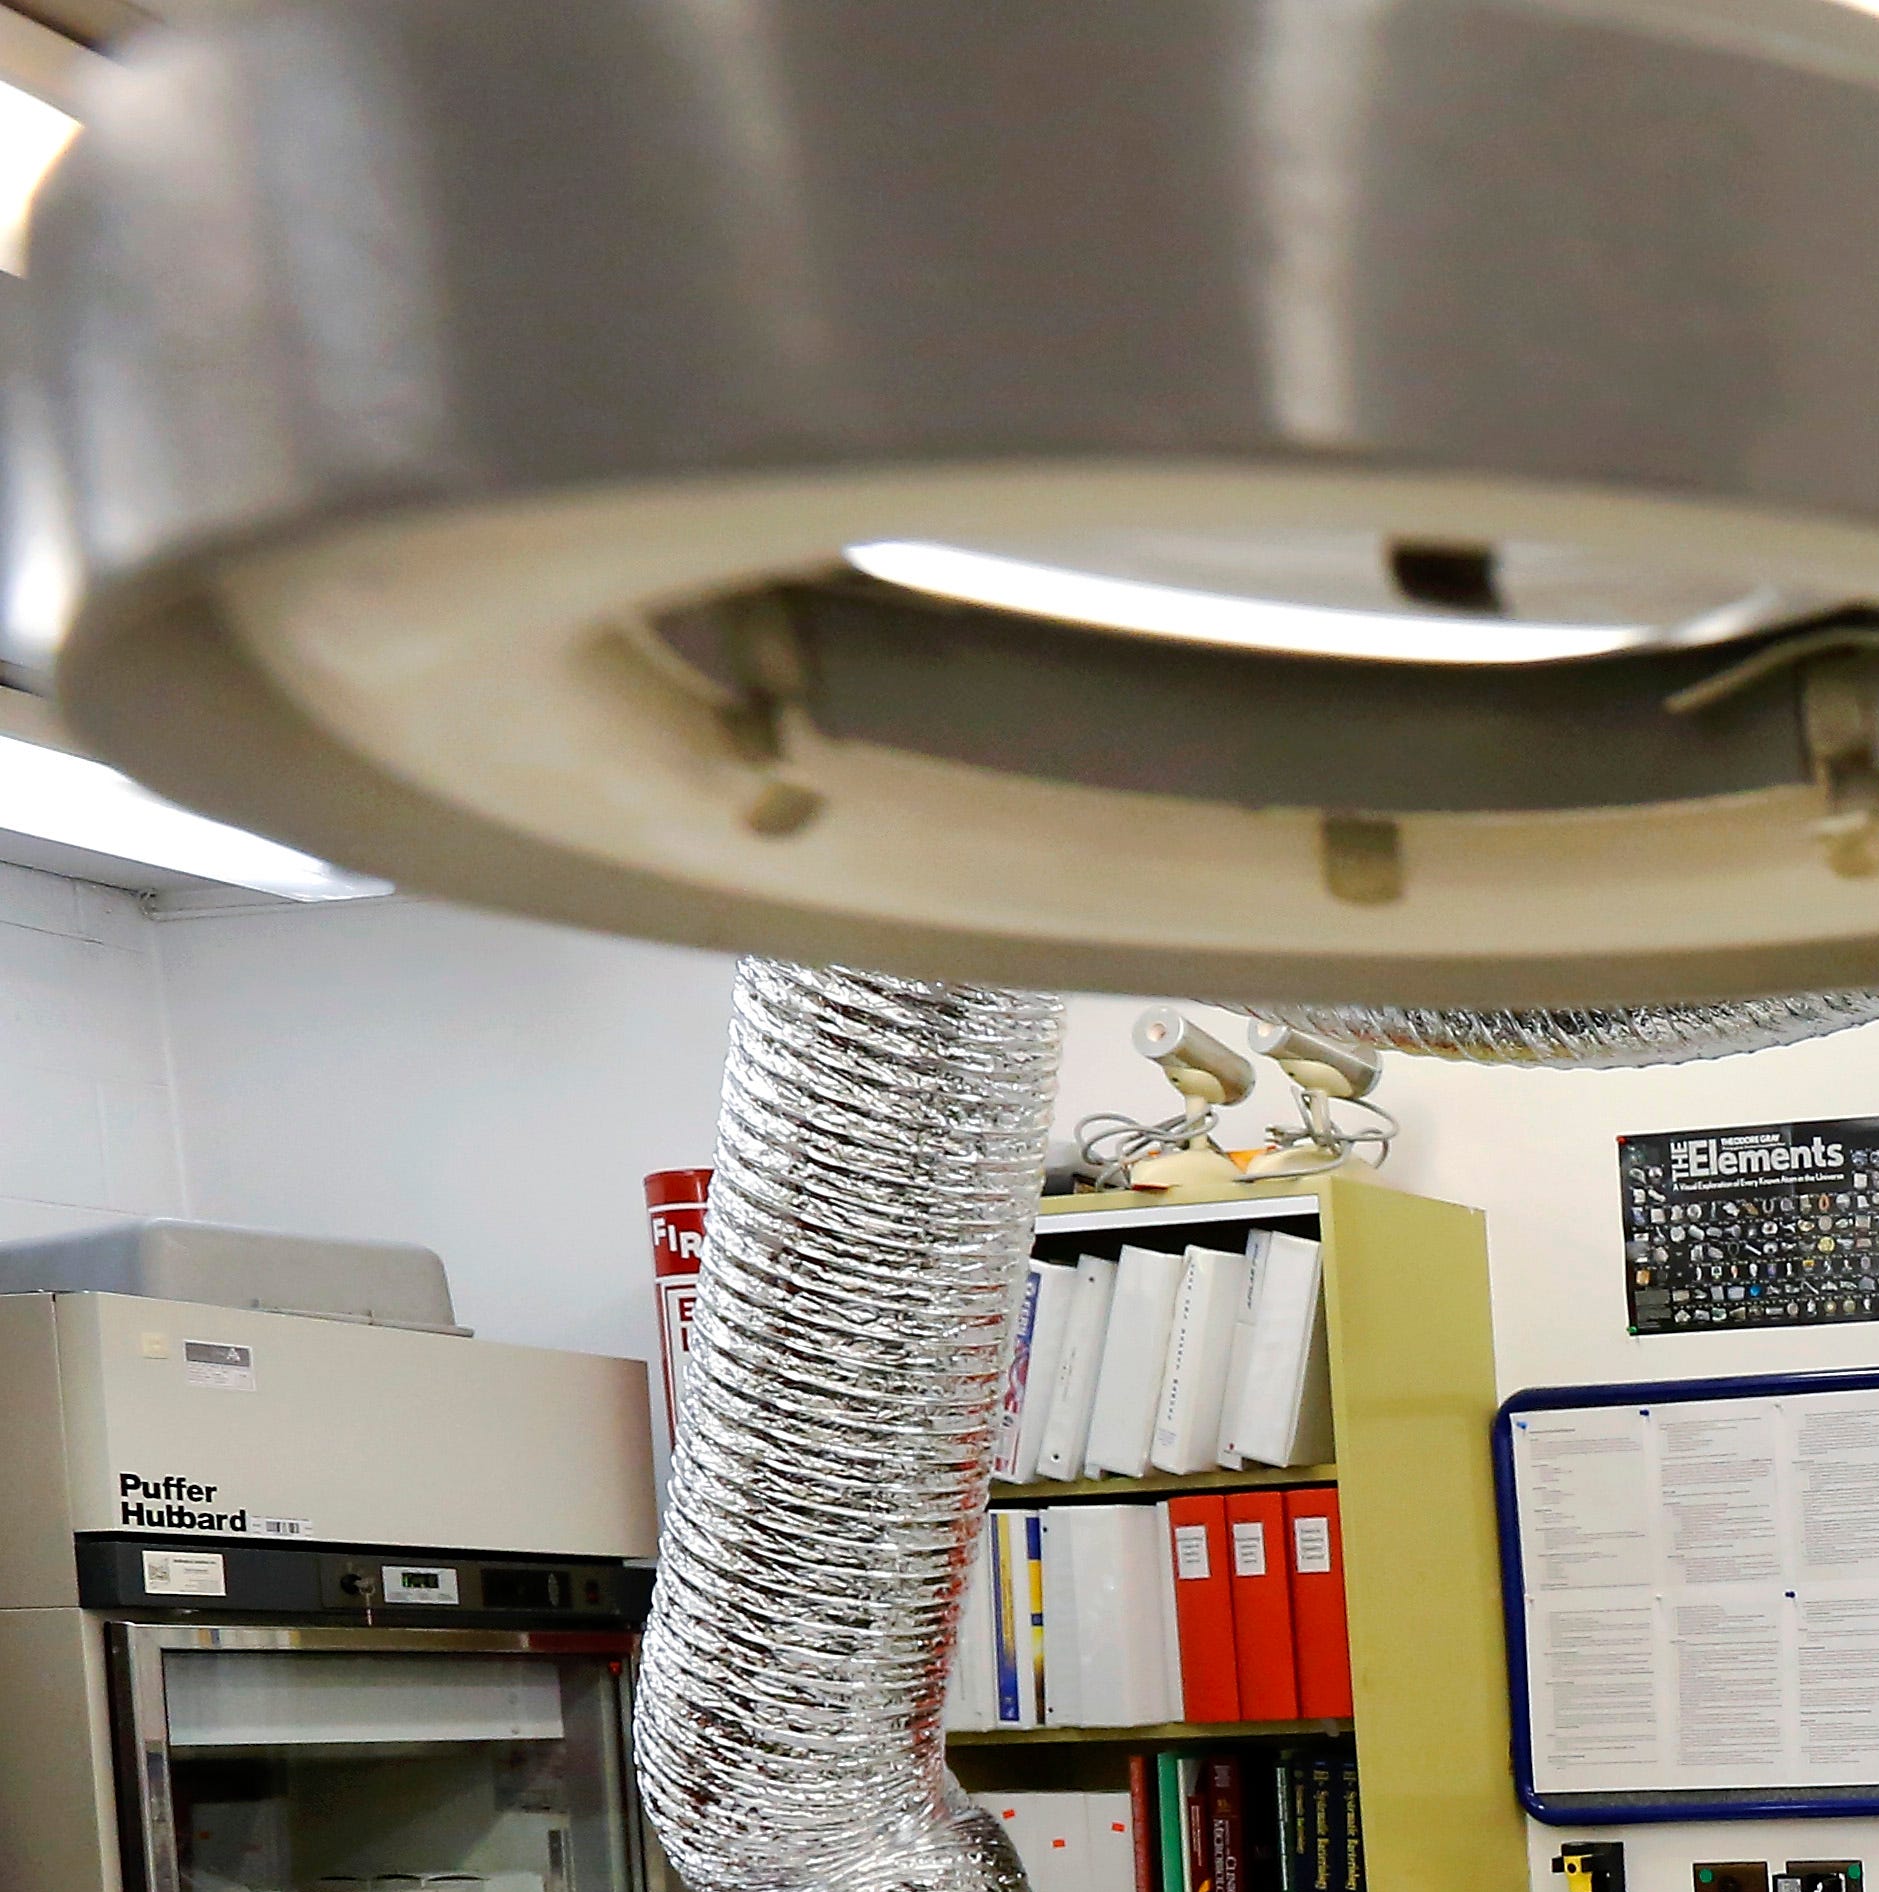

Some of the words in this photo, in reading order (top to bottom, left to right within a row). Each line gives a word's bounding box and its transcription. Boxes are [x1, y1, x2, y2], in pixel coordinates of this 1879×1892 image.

[1670, 1140, 1689, 1182] THE
[1688, 1136, 1845, 1178] Elements
[652, 1217, 702, 1259] FIR
[119, 1473, 217, 1503] Puffer
[121, 1502, 247, 1532] Hubbard
